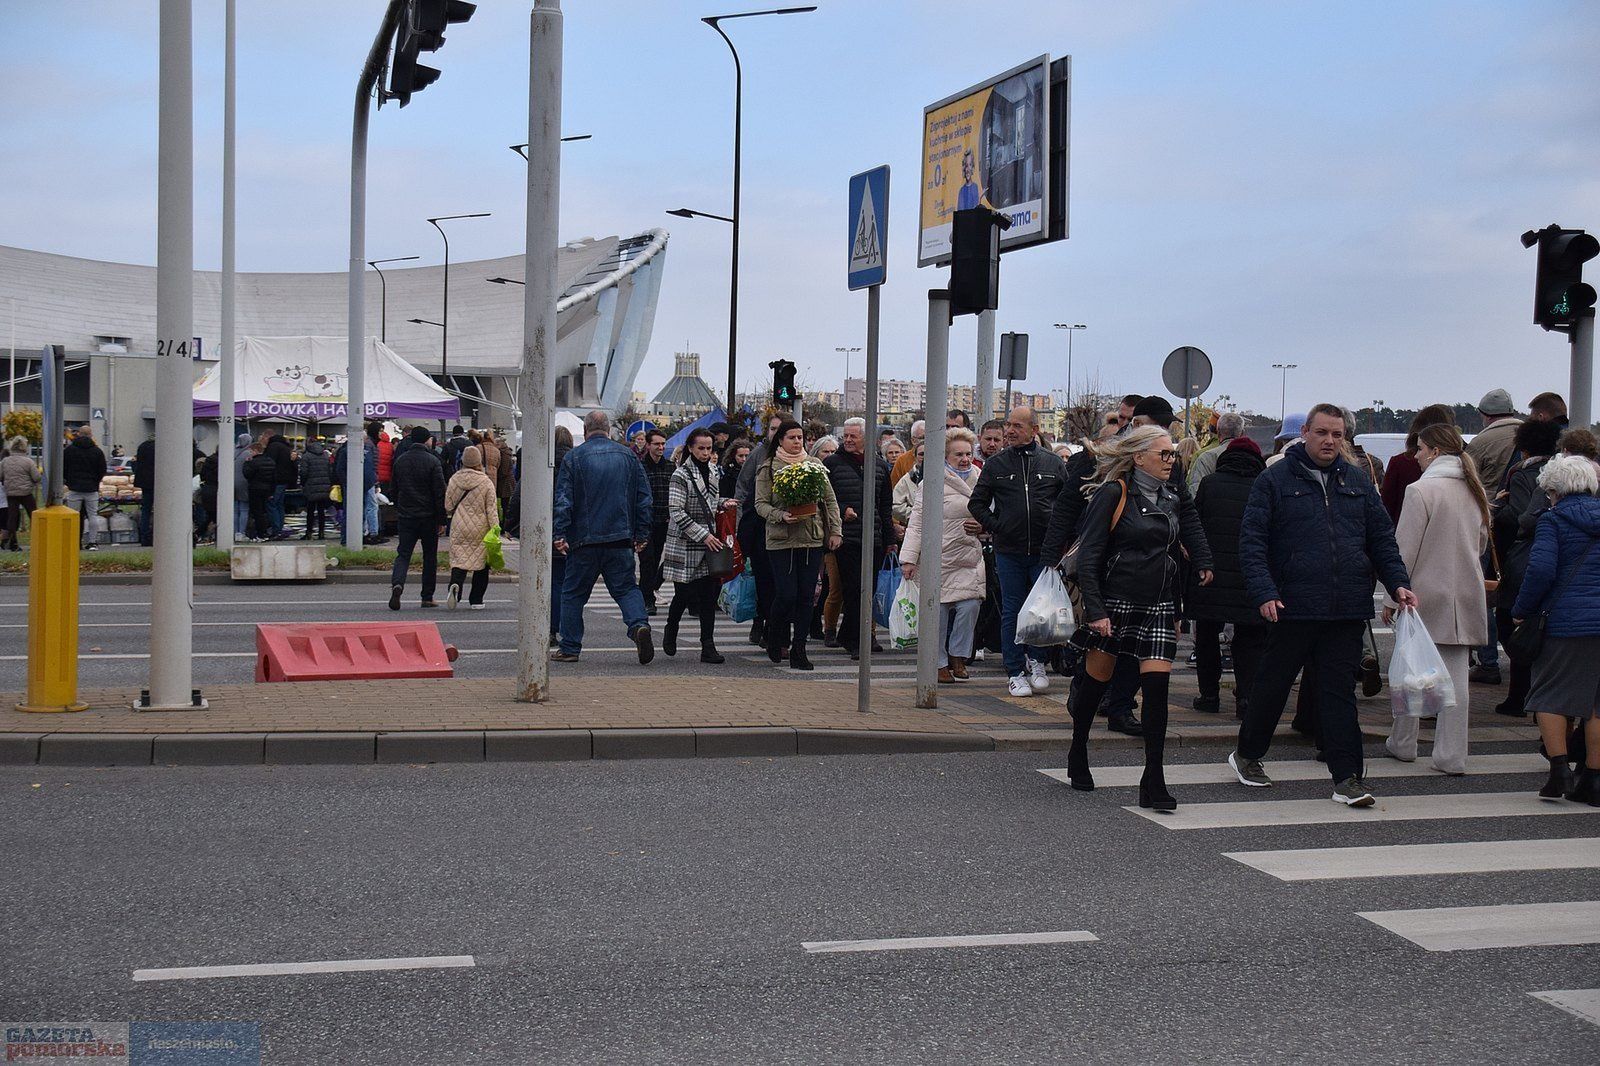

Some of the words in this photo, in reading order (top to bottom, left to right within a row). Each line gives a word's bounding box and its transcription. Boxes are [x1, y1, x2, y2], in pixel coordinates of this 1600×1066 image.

[935, 164, 941, 187] 0
[94, 410, 103, 418] A
[248, 402, 317, 415] KROWKA
[323, 403, 387, 416] HABO
